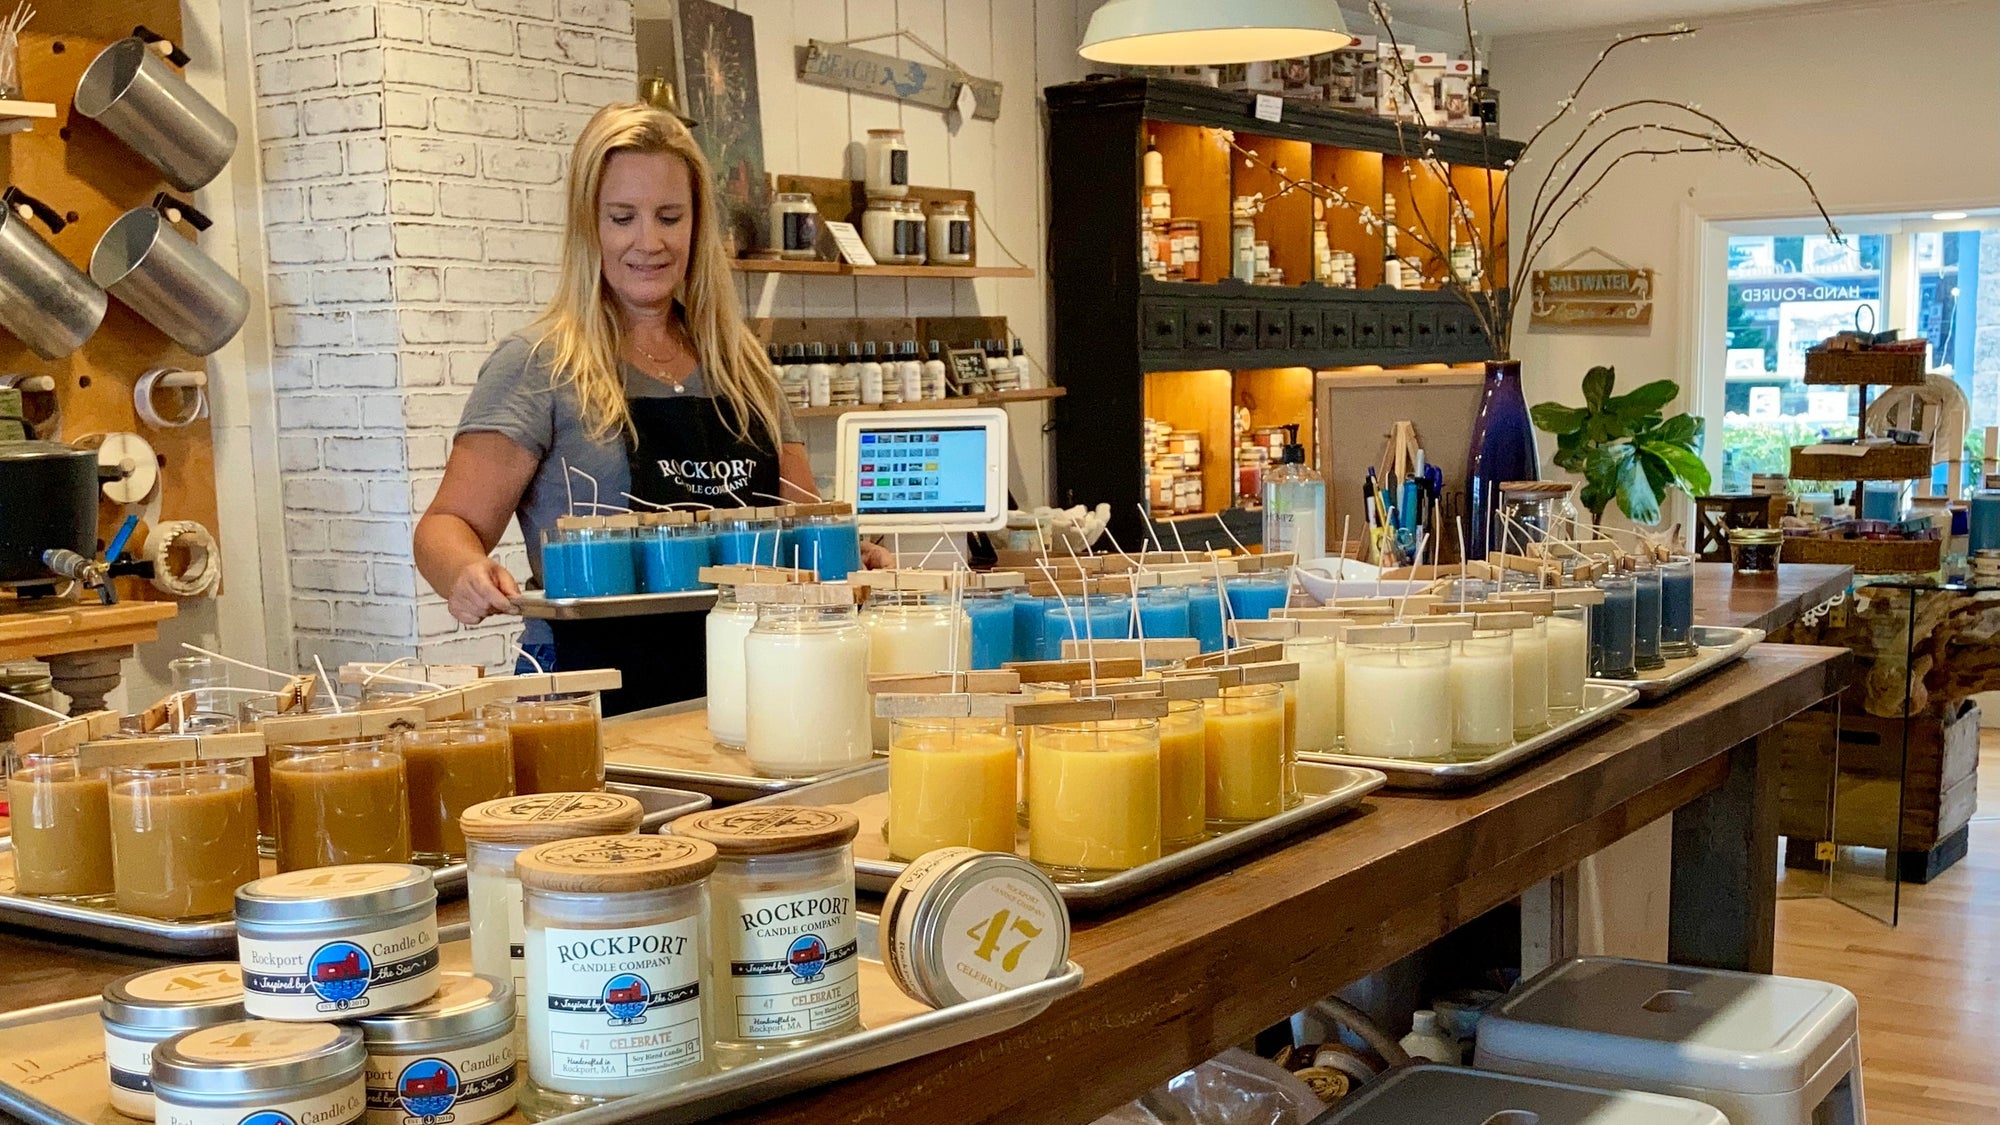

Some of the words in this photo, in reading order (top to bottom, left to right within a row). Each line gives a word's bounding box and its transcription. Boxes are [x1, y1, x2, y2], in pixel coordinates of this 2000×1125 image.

[817, 53, 877, 83] BEACH
[1549, 274, 1629, 292] SALTWATER
[288, 870, 385, 888] 47
[741, 897, 849, 931] ROCKPORT
[757, 926, 798, 937] CANDLE
[800, 917, 841, 933] COMPANY
[558, 935, 688, 963] ROCKPORT
[967, 908, 1043, 972] 47
[251, 950, 304, 968] Rockport
[372, 936, 416, 957] Candle
[572, 962, 616, 972] CANDLE
[619, 955, 672, 971] COMPANY
[746, 964, 776, 974] Inspired
[164, 969, 240, 992] 47
[260, 977, 294, 993] Inspired
[295, 977, 309, 993] by
[376, 967, 394, 979] the
[396, 964, 414, 976] Sea
[560, 999, 591, 1011] Inspired
[592, 1000, 602, 1012] by
[763, 999, 774, 1009] 47
[791, 987, 842, 1007] CELEBRATE
[749, 1025, 785, 1034] Rockport,
[787, 1023, 802, 1031] MA
[579, 1039, 590, 1050] 47
[609, 1031, 672, 1050] CELEBRATE
[567, 1056, 604, 1066] Handcrafted
[645, 1051, 662, 1060] Blend
[366, 1070, 393, 1081] port
[460, 1053, 499, 1073] Candle
[562, 1065, 599, 1074] Rockport,
[600, 1065, 617, 1074] MA
[464, 1083, 480, 1095] the
[481, 1079, 497, 1092] Sea
[301, 1103, 346, 1125] Candle
